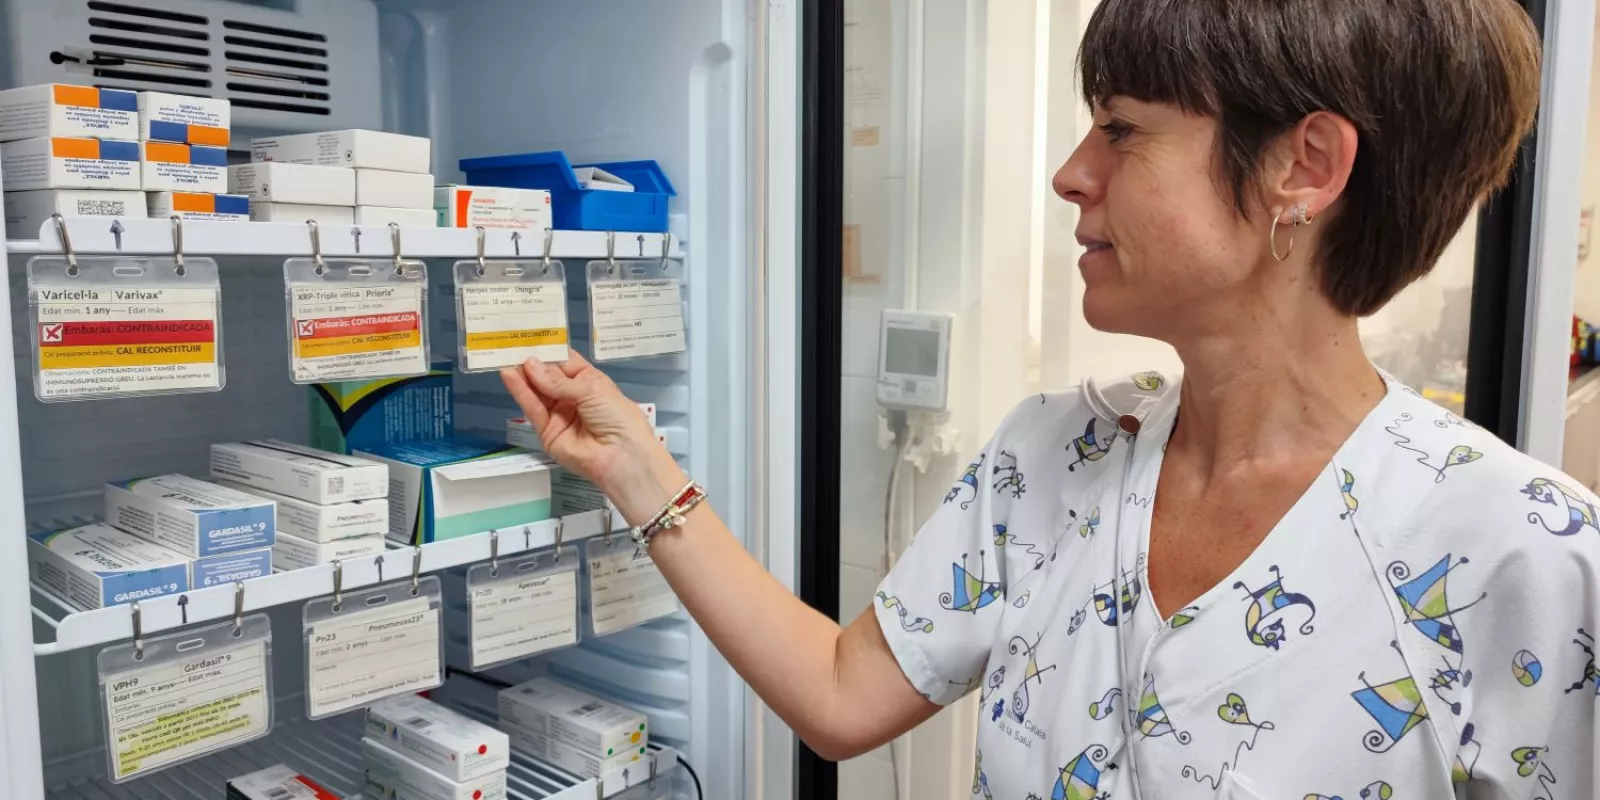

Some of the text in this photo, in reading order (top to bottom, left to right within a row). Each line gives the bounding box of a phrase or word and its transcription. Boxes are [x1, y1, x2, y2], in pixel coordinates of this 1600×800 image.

[42, 290, 98, 300] Varicel·la
[351, 314, 416, 326] CONTRAINDICADA
[117, 323, 210, 333] CONTRAINDICADA
[137, 345, 202, 353] RECONSTITUIR
[208, 522, 266, 537] GARDASIL® 9
[204, 569, 261, 586] GARDASIL® 9
[114, 583, 178, 602] GARDASIL® 9
[316, 633, 336, 644] Pn23
[353, 641, 368, 649] anys
[113, 678, 138, 691] VPH9
[184, 655, 224, 672] Gardasil®
[114, 694, 130, 702] Edat
[188, 673, 203, 682] Edat
